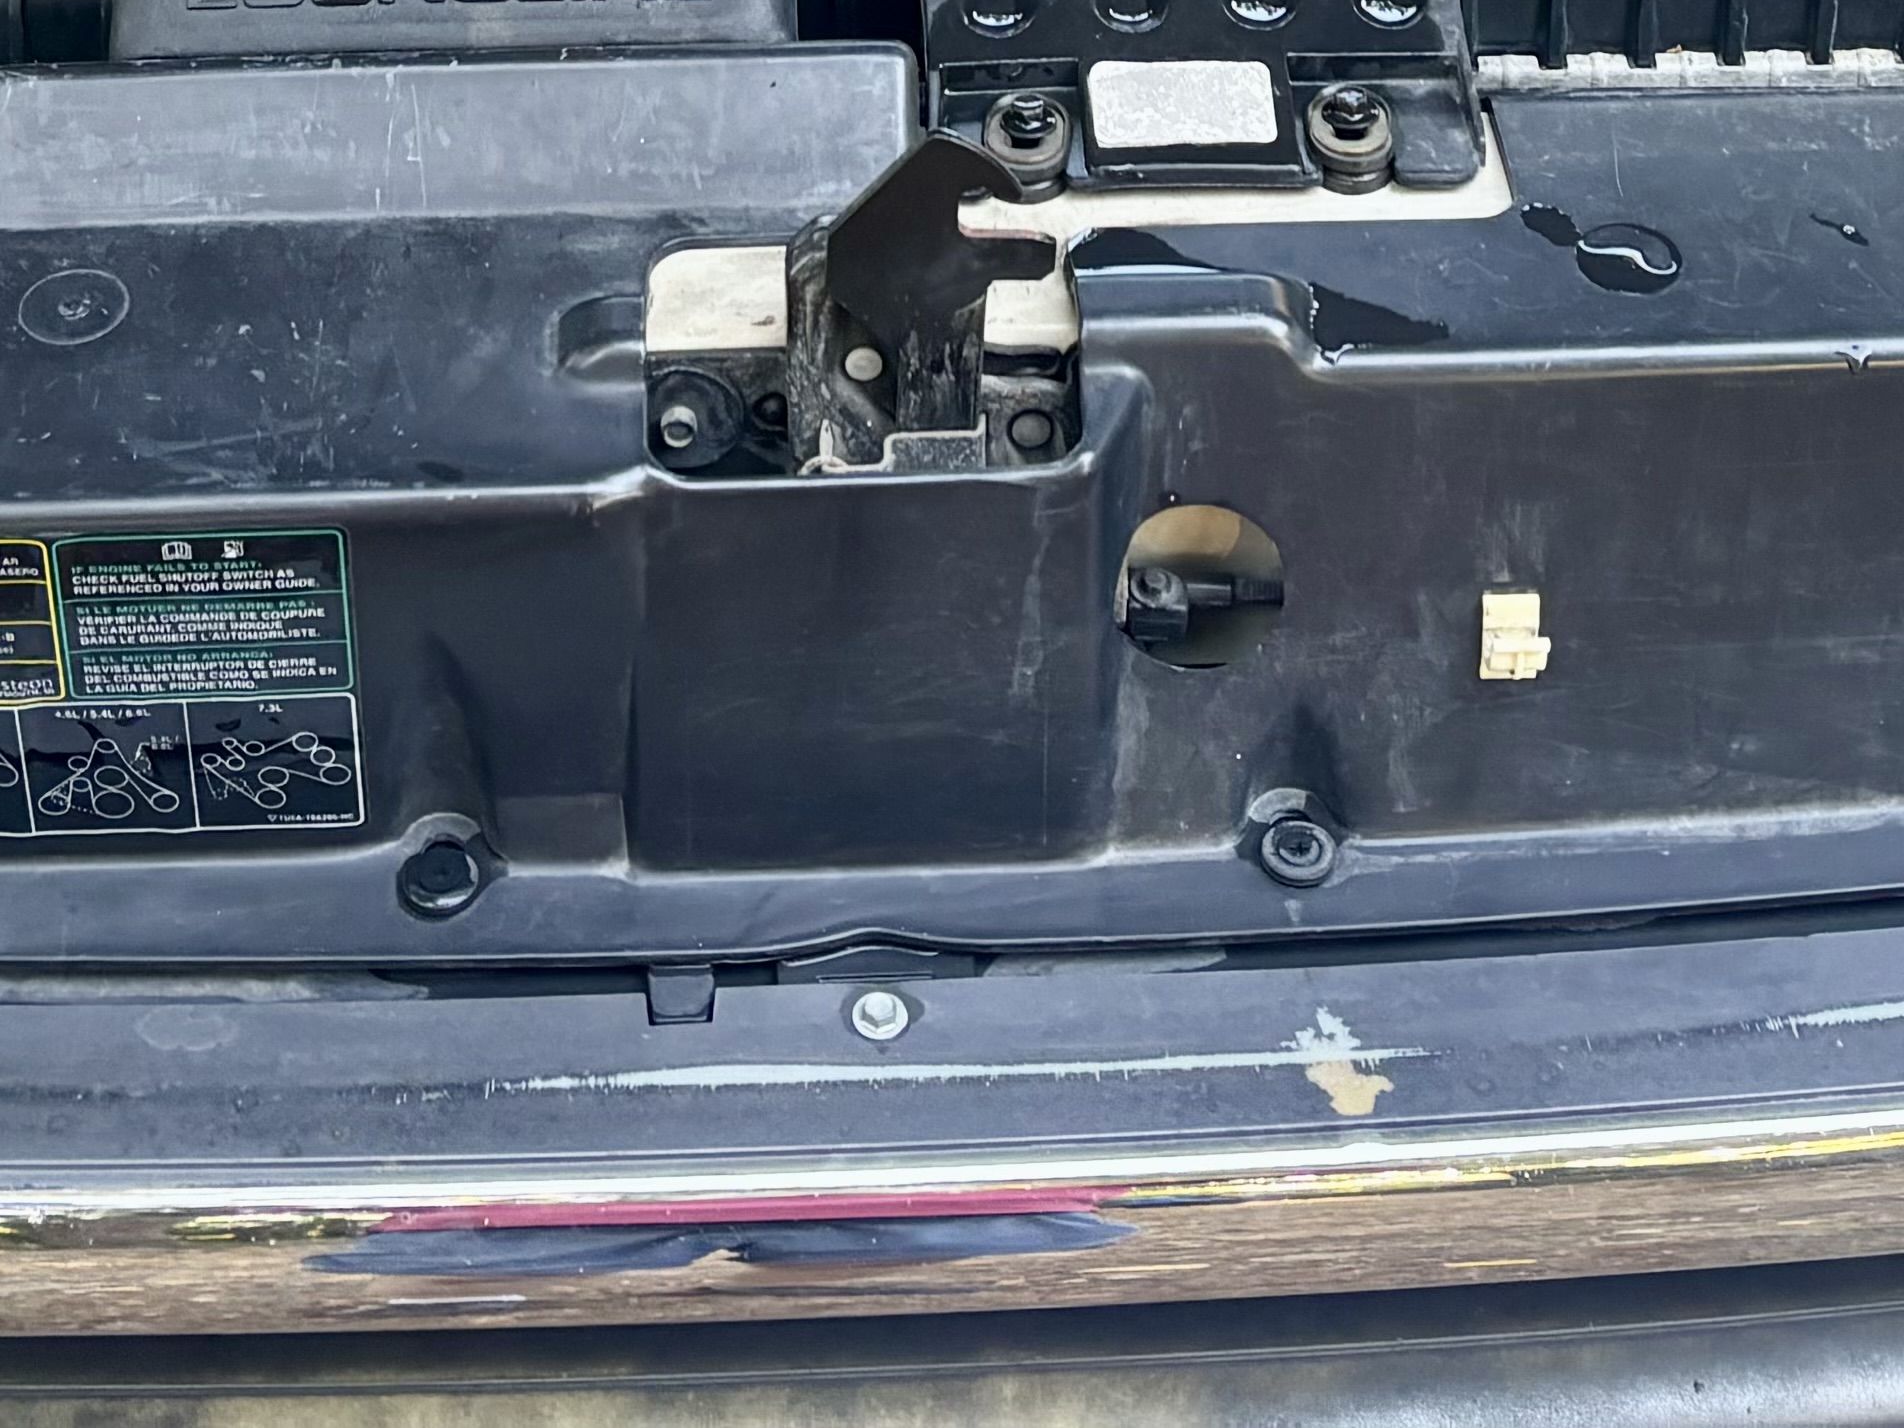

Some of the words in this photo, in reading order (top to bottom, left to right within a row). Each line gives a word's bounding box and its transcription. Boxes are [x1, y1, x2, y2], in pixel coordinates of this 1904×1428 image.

[2, 557, 19, 567] AR
[72, 574, 119, 586] CHECK
[121, 573, 156, 585] FUEL
[158, 571, 219, 584] SHUTOFF
[222, 569, 274, 581] SWITCH
[73, 583, 163, 595] REFERENCED
[182, 582, 220, 593] YOUR
[222, 580, 272, 591] OWNER
[159, 611, 237, 623] COMMANDE
[239, 610, 258, 621] DE
[261, 608, 326, 619] COUPURE
[78, 626, 97, 636] DE
[177, 621, 228, 633] COMME
[79, 635, 116, 646] DANS
[119, 634, 137, 645] LE
[152, 660, 245, 673] INTERRUPTOR
[84, 673, 111, 685] DEL
[112, 671, 206, 684] COMBUSTIBLE
[209, 669, 249, 681] COMO
[271, 666, 317, 679] INDICA
[318, 665, 337, 677] EN
[85, 683, 103, 694] LA
[140, 681, 166, 692] DEL
